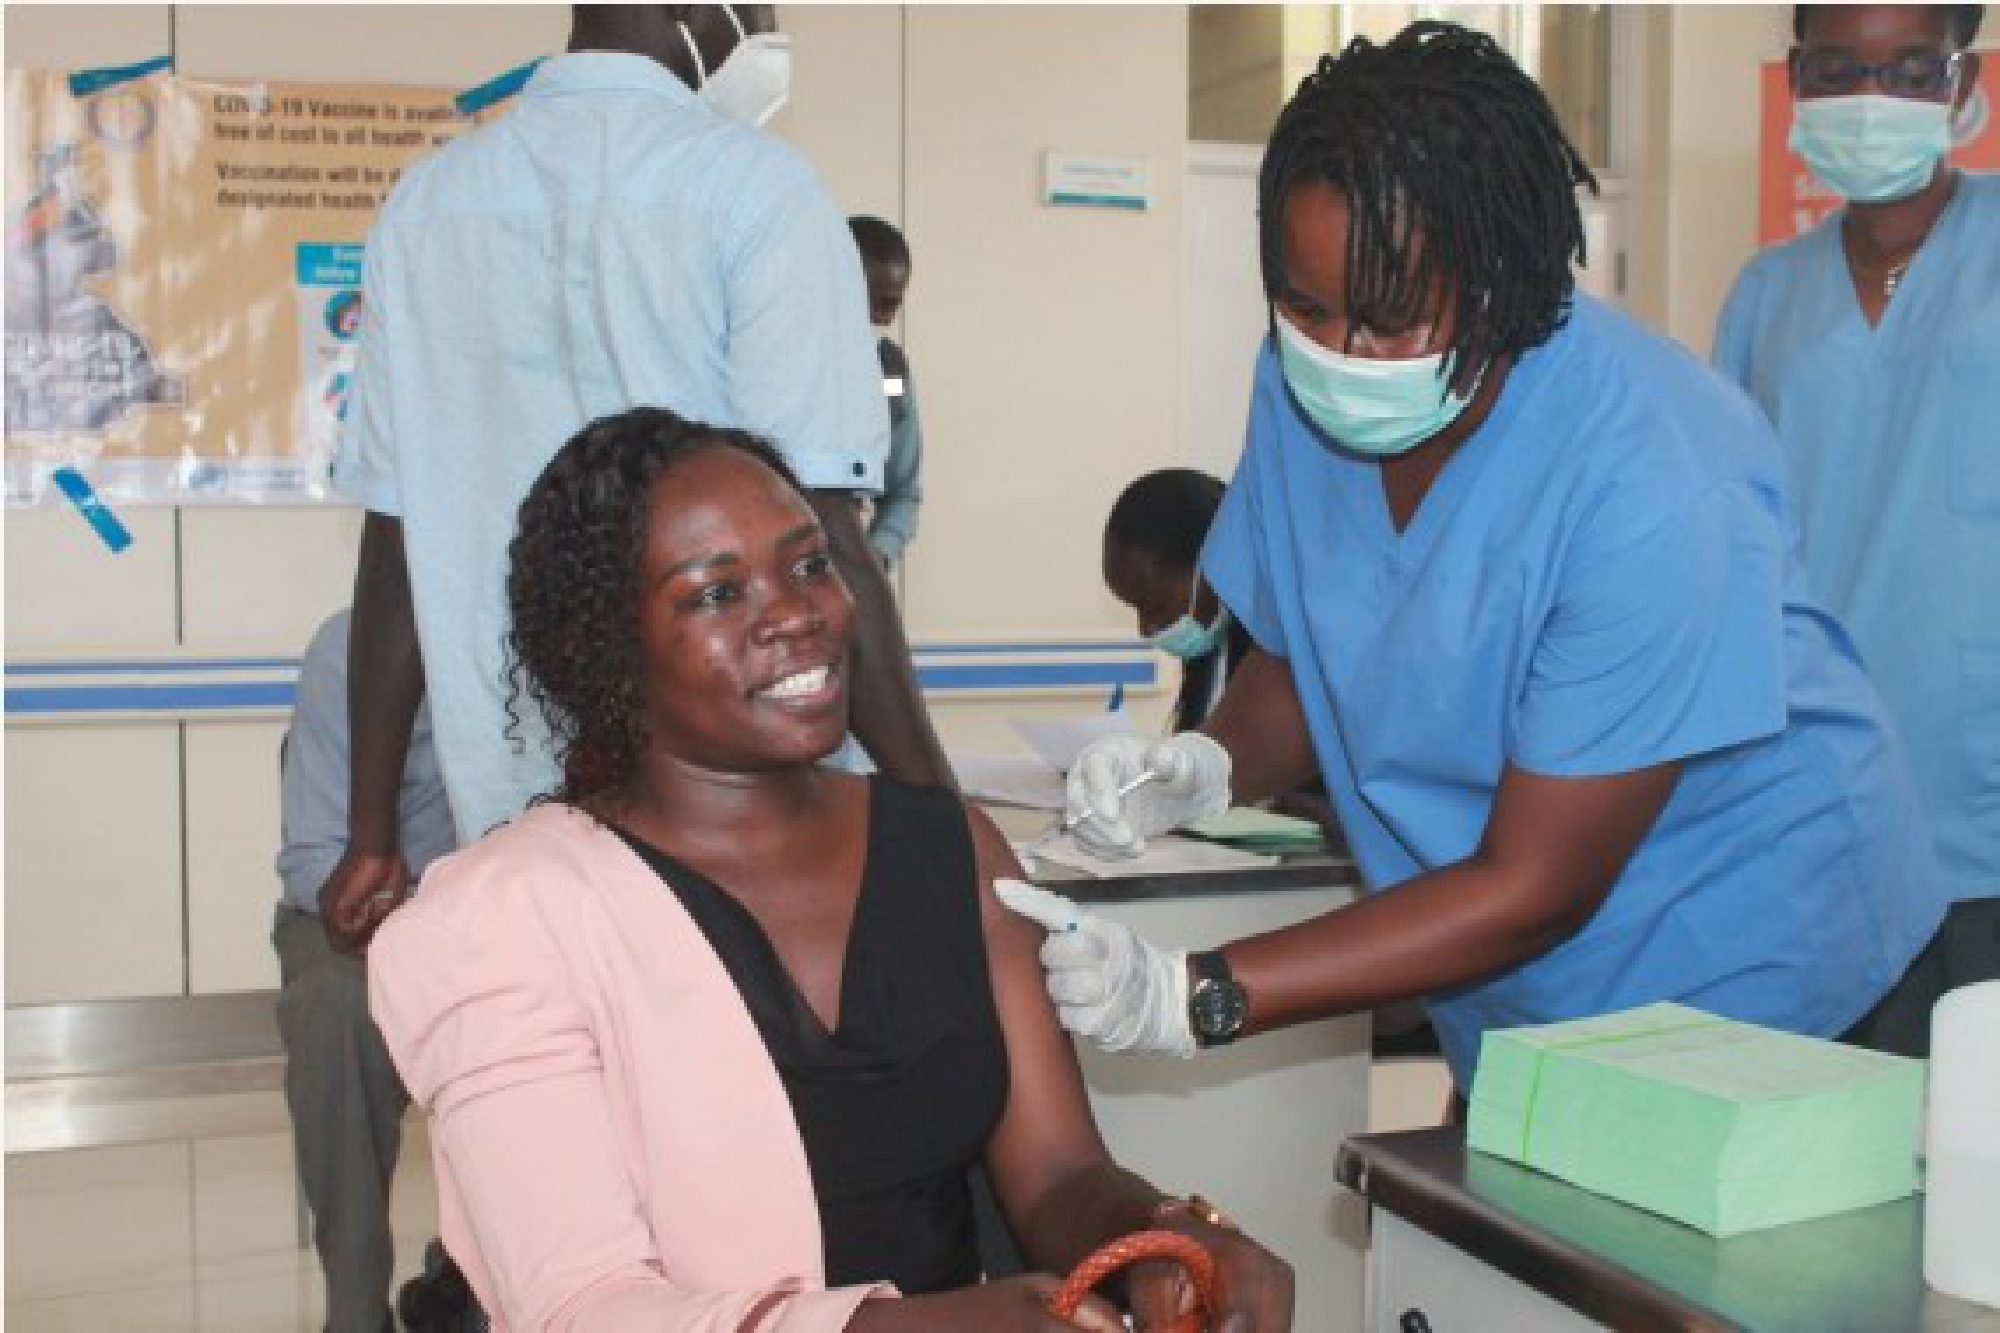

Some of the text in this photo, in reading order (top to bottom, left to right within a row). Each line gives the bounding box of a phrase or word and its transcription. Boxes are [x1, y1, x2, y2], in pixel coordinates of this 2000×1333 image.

[308, 98, 379, 119] Vaccine
[384, 103, 398, 120] is
[213, 123, 250, 140] free
[256, 124, 275, 140] of
[280, 126, 316, 143] cost
[322, 126, 338, 144] to
[346, 126, 366, 144] all
[371, 129, 424, 147] health
[214, 161, 319, 182] Vaccination
[325, 166, 358, 182] will
[364, 166, 383, 183] be
[217, 190, 317, 210] designated
[322, 191, 375, 208] health
